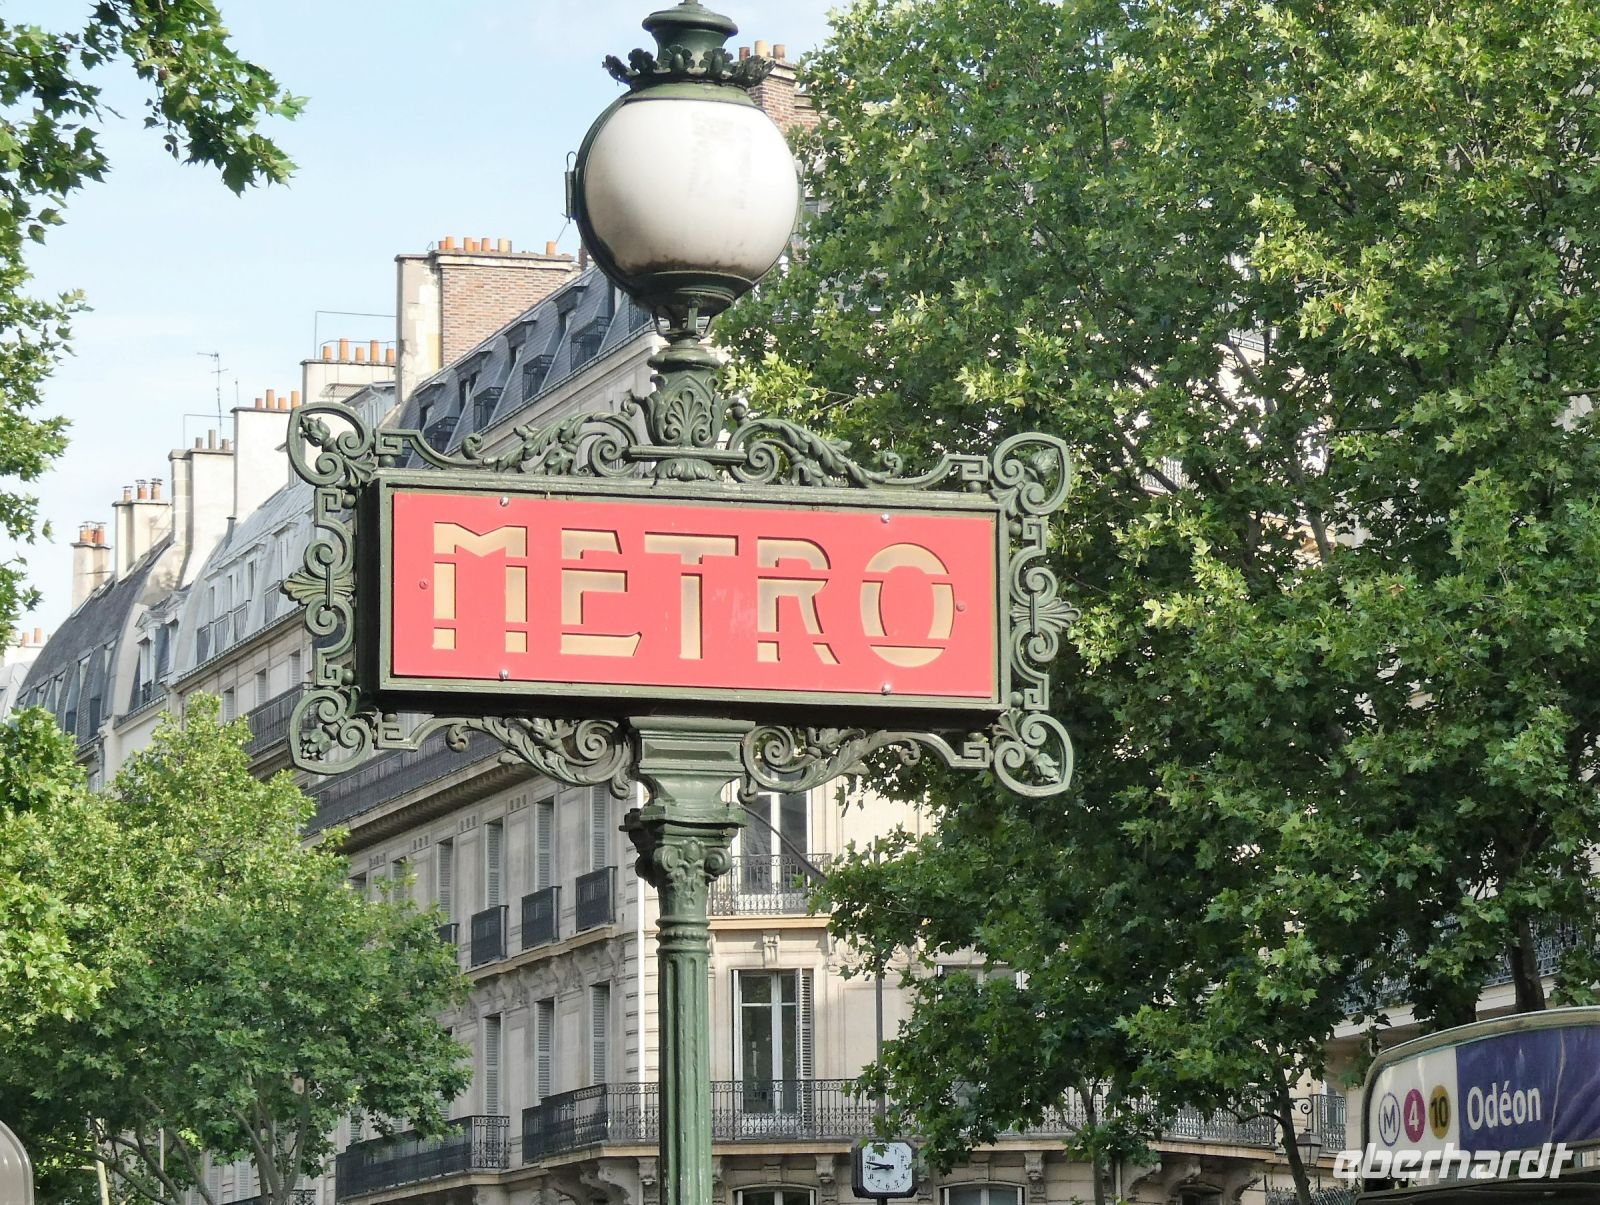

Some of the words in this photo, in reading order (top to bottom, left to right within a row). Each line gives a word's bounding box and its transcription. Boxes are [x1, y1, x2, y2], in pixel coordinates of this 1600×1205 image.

[433, 521, 955, 667] METRO
[1408, 1100, 1420, 1131] 4
[1430, 1096, 1449, 1128] 10
[1467, 1081, 1541, 1130] Odéon
